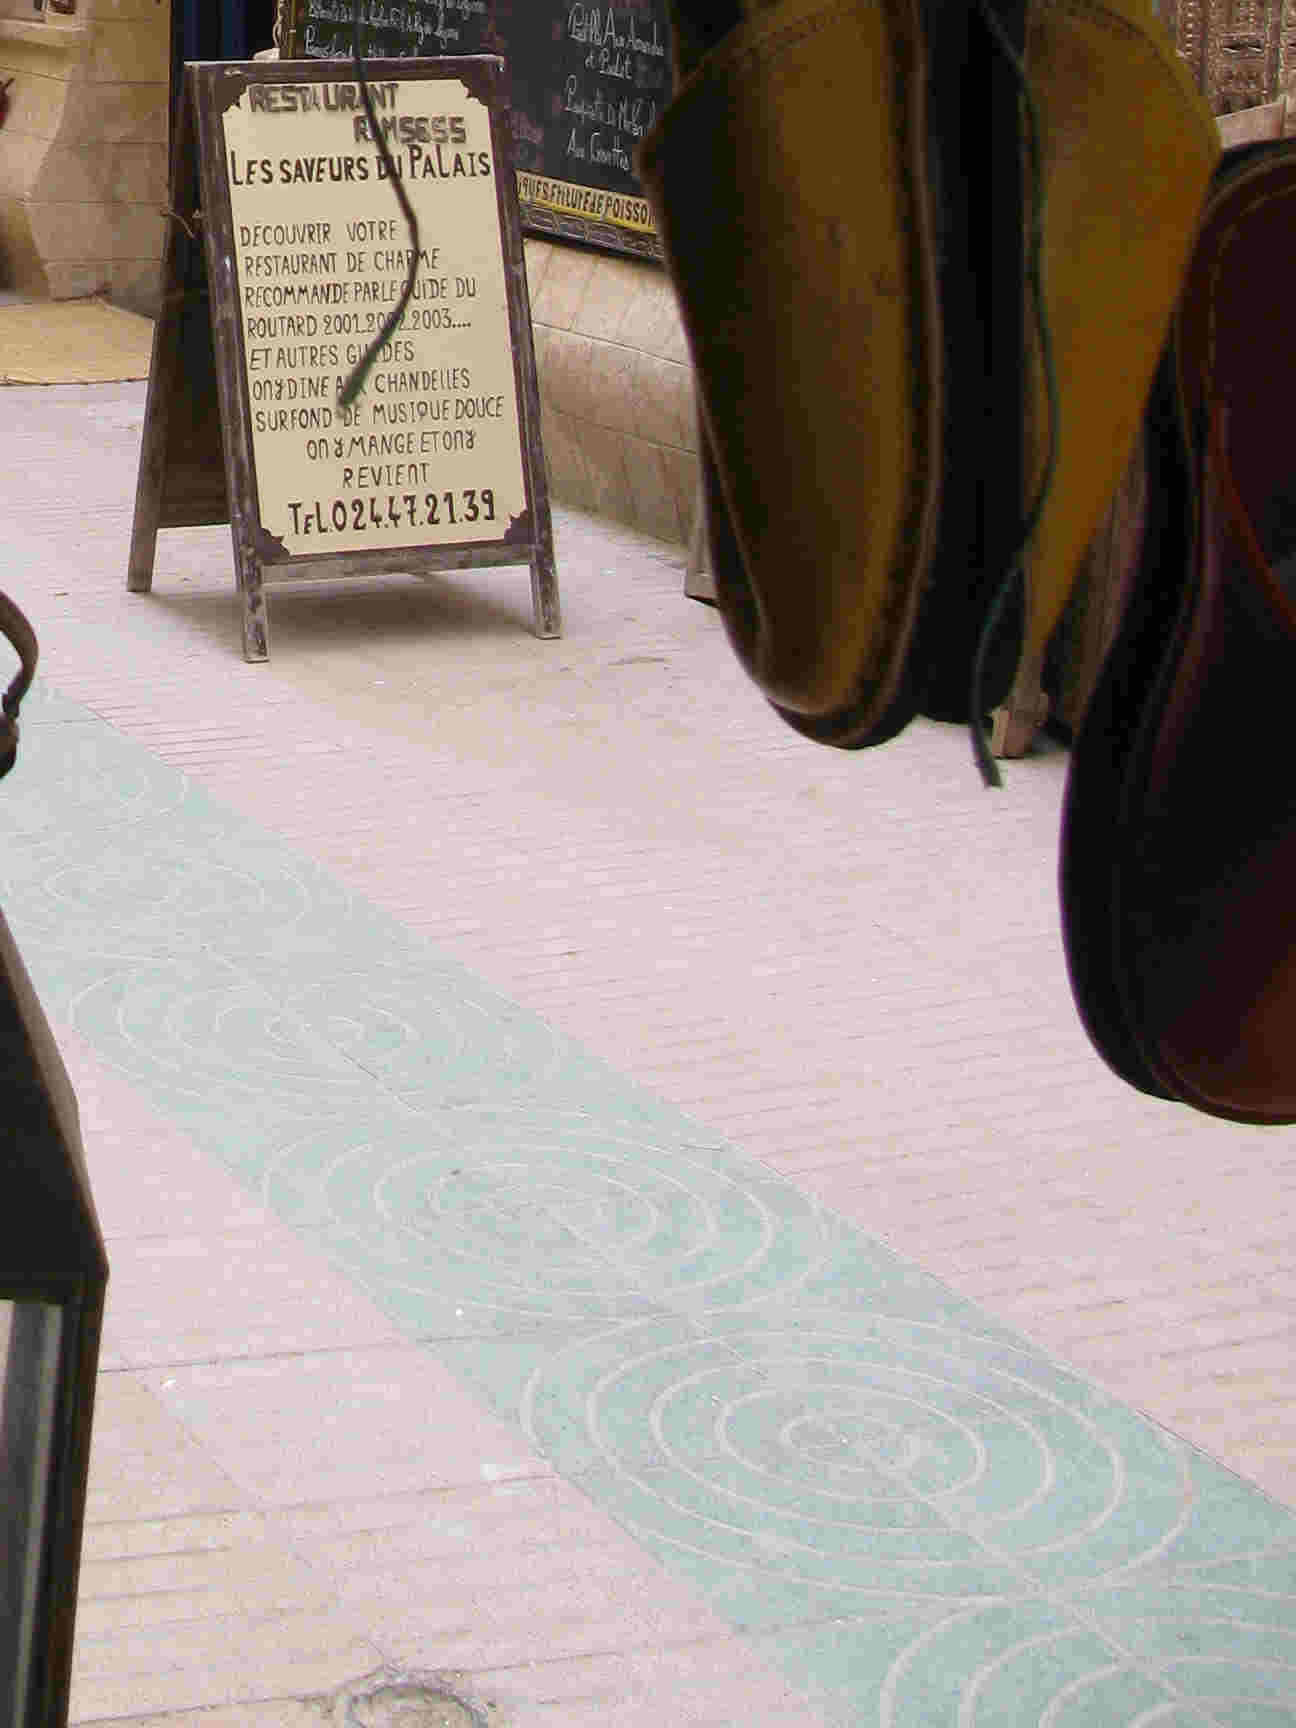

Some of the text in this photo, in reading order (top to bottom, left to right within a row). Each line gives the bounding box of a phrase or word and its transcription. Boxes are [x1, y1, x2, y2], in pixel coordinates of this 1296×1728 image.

[248, 81, 399, 113] RESTAURNT
[354, 115, 466, 145] RMSESS
[230, 149, 273, 186] LES
[280, 155, 369, 184] SAVEURS
[408, 143, 491, 179] PALAIS
[240, 220, 399, 248] DECOUVRIR VOTRE
[244, 252, 337, 278] RESTAURANT
[347, 251, 365, 273] DE
[455, 276, 477, 298] DU
[247, 315, 317, 339] ROUTARD
[249, 341, 415, 371] ET AUTRES GUDES
[287, 375, 330, 400] DINE
[374, 368, 471, 393] CHANDELLES
[342, 406, 361, 427] DE
[372, 400, 450, 424] MUSIQUE
[454, 395, 505, 419] DOUCE
[347, 432, 415, 457] MANGE
[342, 462, 431, 489] REVIENT
